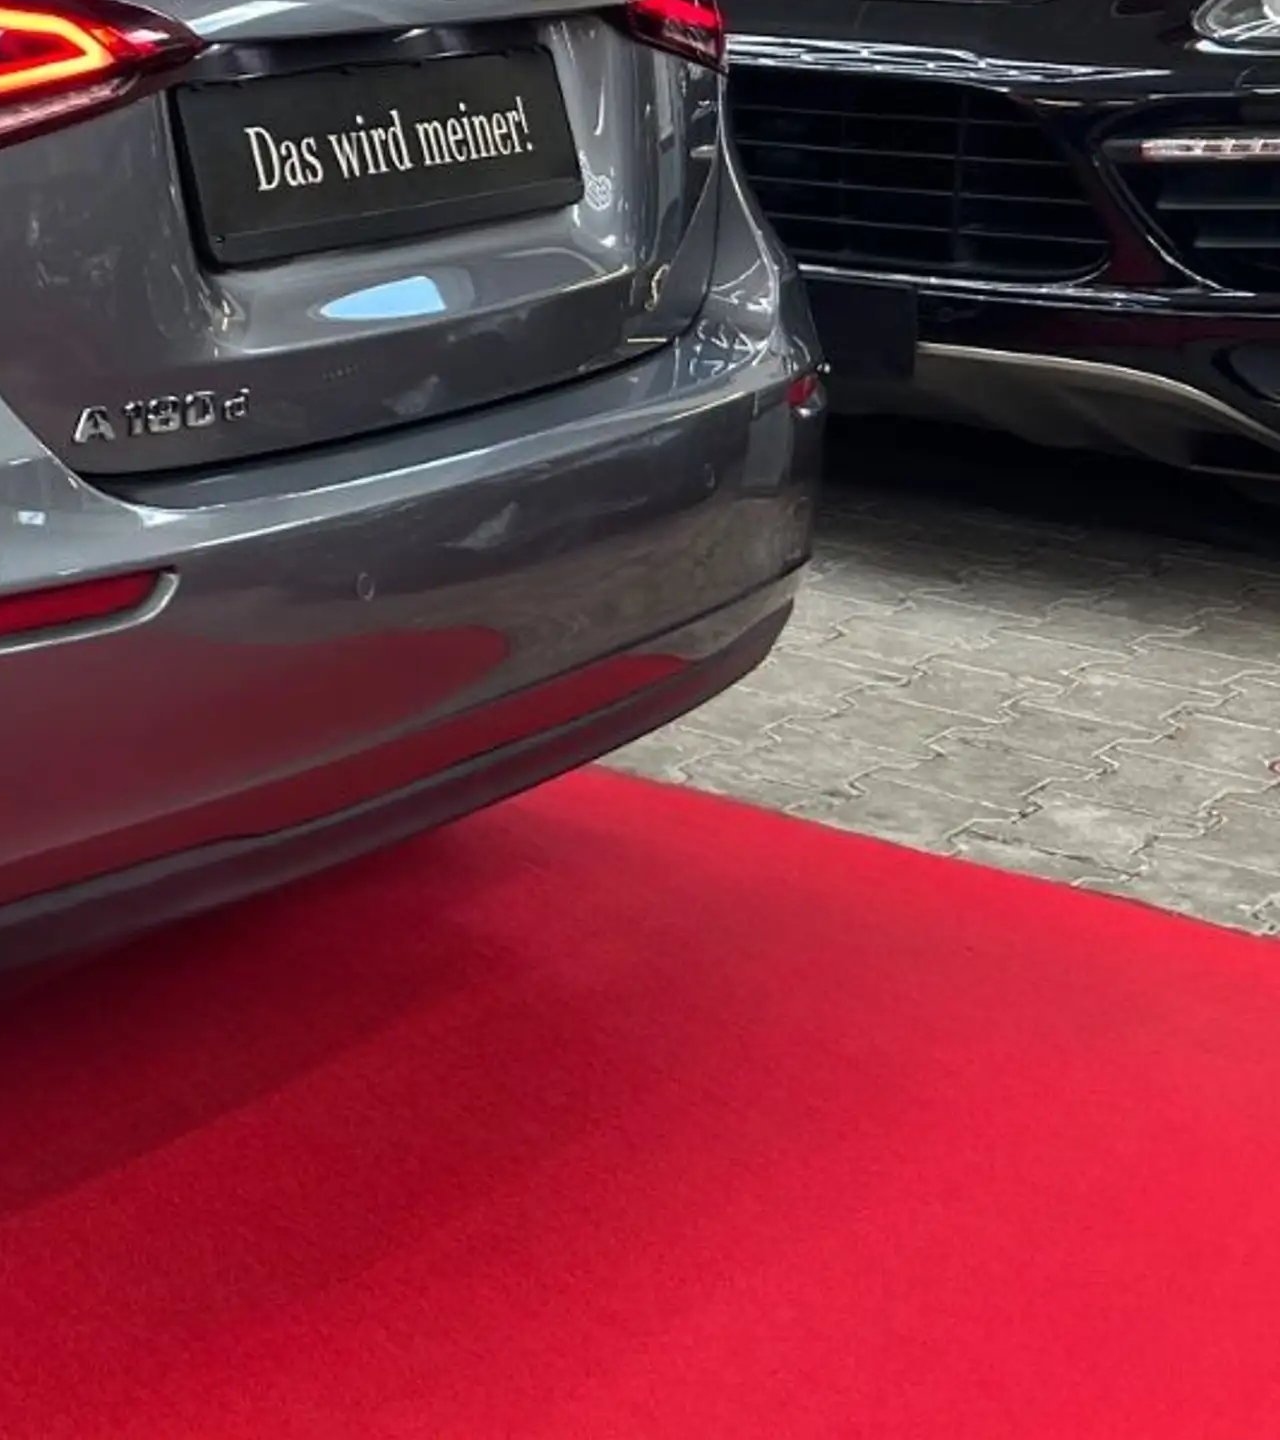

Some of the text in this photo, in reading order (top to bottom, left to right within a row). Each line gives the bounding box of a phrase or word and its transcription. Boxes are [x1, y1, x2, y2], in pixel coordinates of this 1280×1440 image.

[244, 95, 534, 192] Das wird meiner!
[72, 386, 251, 443] A 180 d
